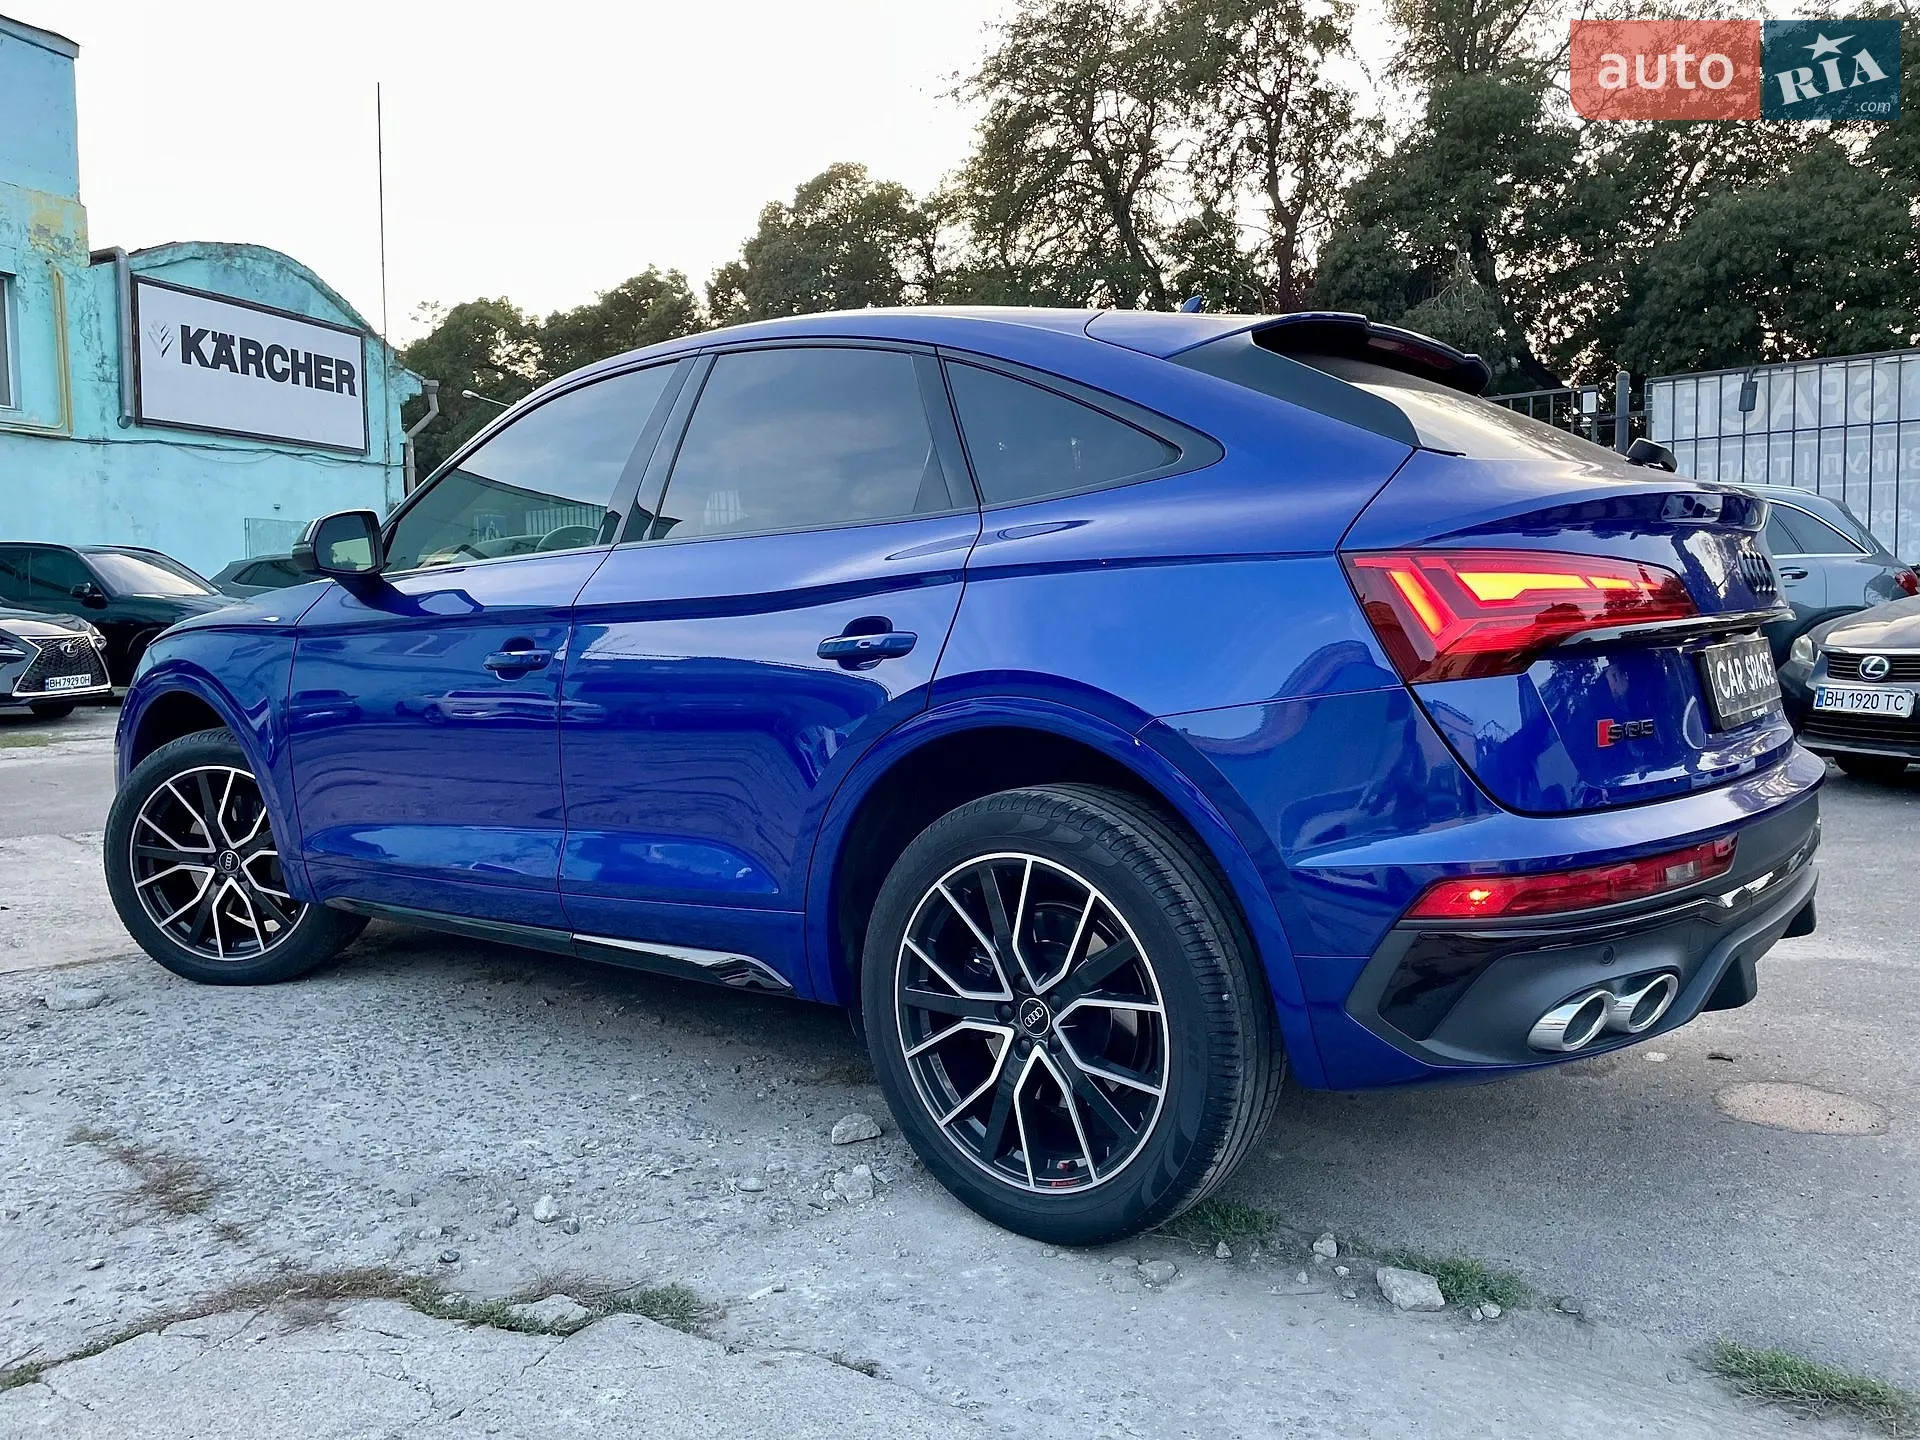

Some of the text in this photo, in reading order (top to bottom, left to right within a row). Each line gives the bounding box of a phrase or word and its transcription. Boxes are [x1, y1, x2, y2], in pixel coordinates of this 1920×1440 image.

[180, 323, 357, 397] KÄRCHER
[49, 679, 62, 688] BH
[62, 677, 79, 686] 7929
[1717, 652, 1775, 699] CAR SPACE
[1824, 691, 1845, 708] BH
[1848, 692, 1880, 710] 1920
[1884, 694, 1905, 711] TC
